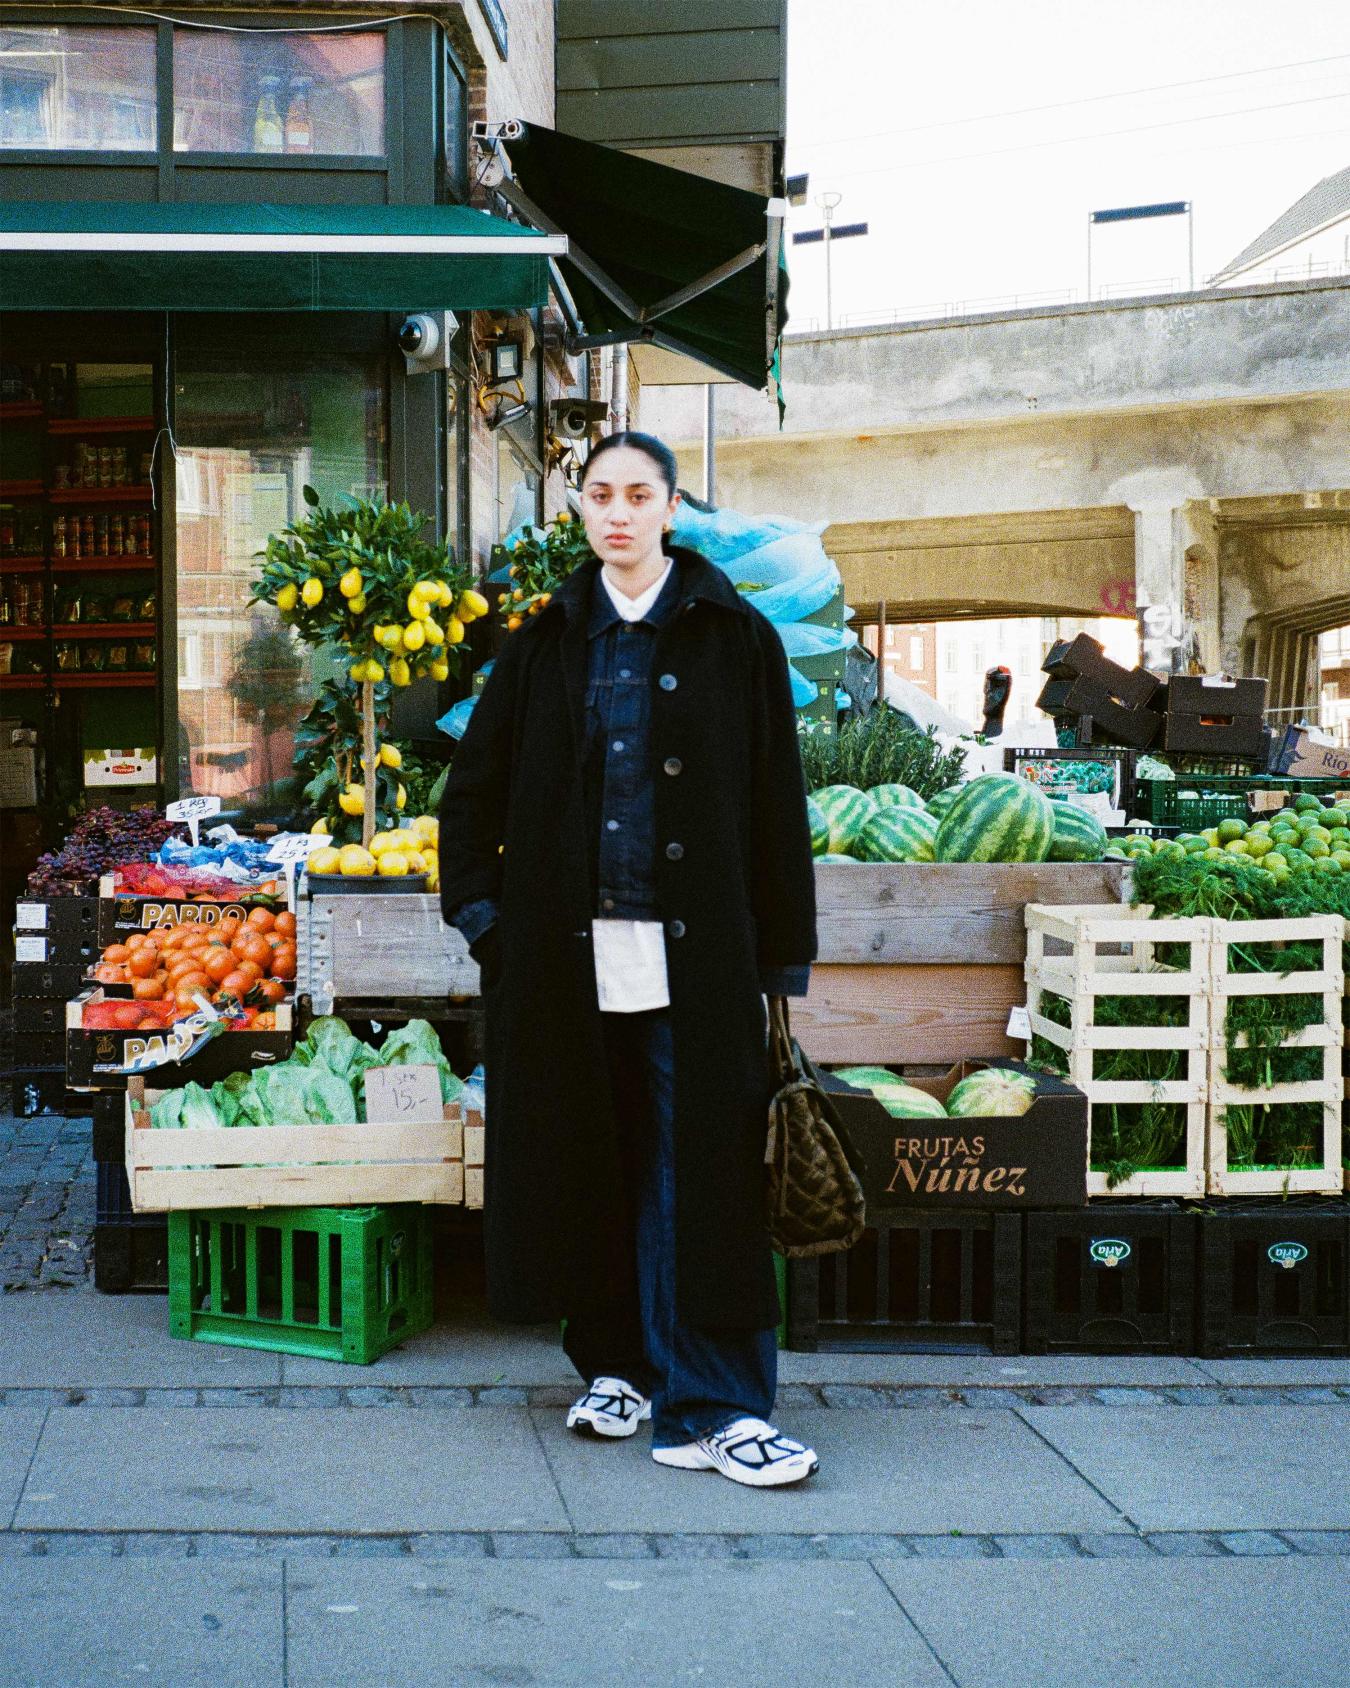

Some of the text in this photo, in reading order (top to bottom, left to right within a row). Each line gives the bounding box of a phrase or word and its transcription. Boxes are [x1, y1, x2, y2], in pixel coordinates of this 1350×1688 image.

[1321, 752, 1348, 770] Rio
[141, 903, 247, 929] PARDO
[894, 1136, 985, 1157] FRUTAS
[885, 1156, 1028, 1196] Núñez
[1098, 1245, 1124, 1257] Arla
[1275, 1248, 1301, 1259] Arla
